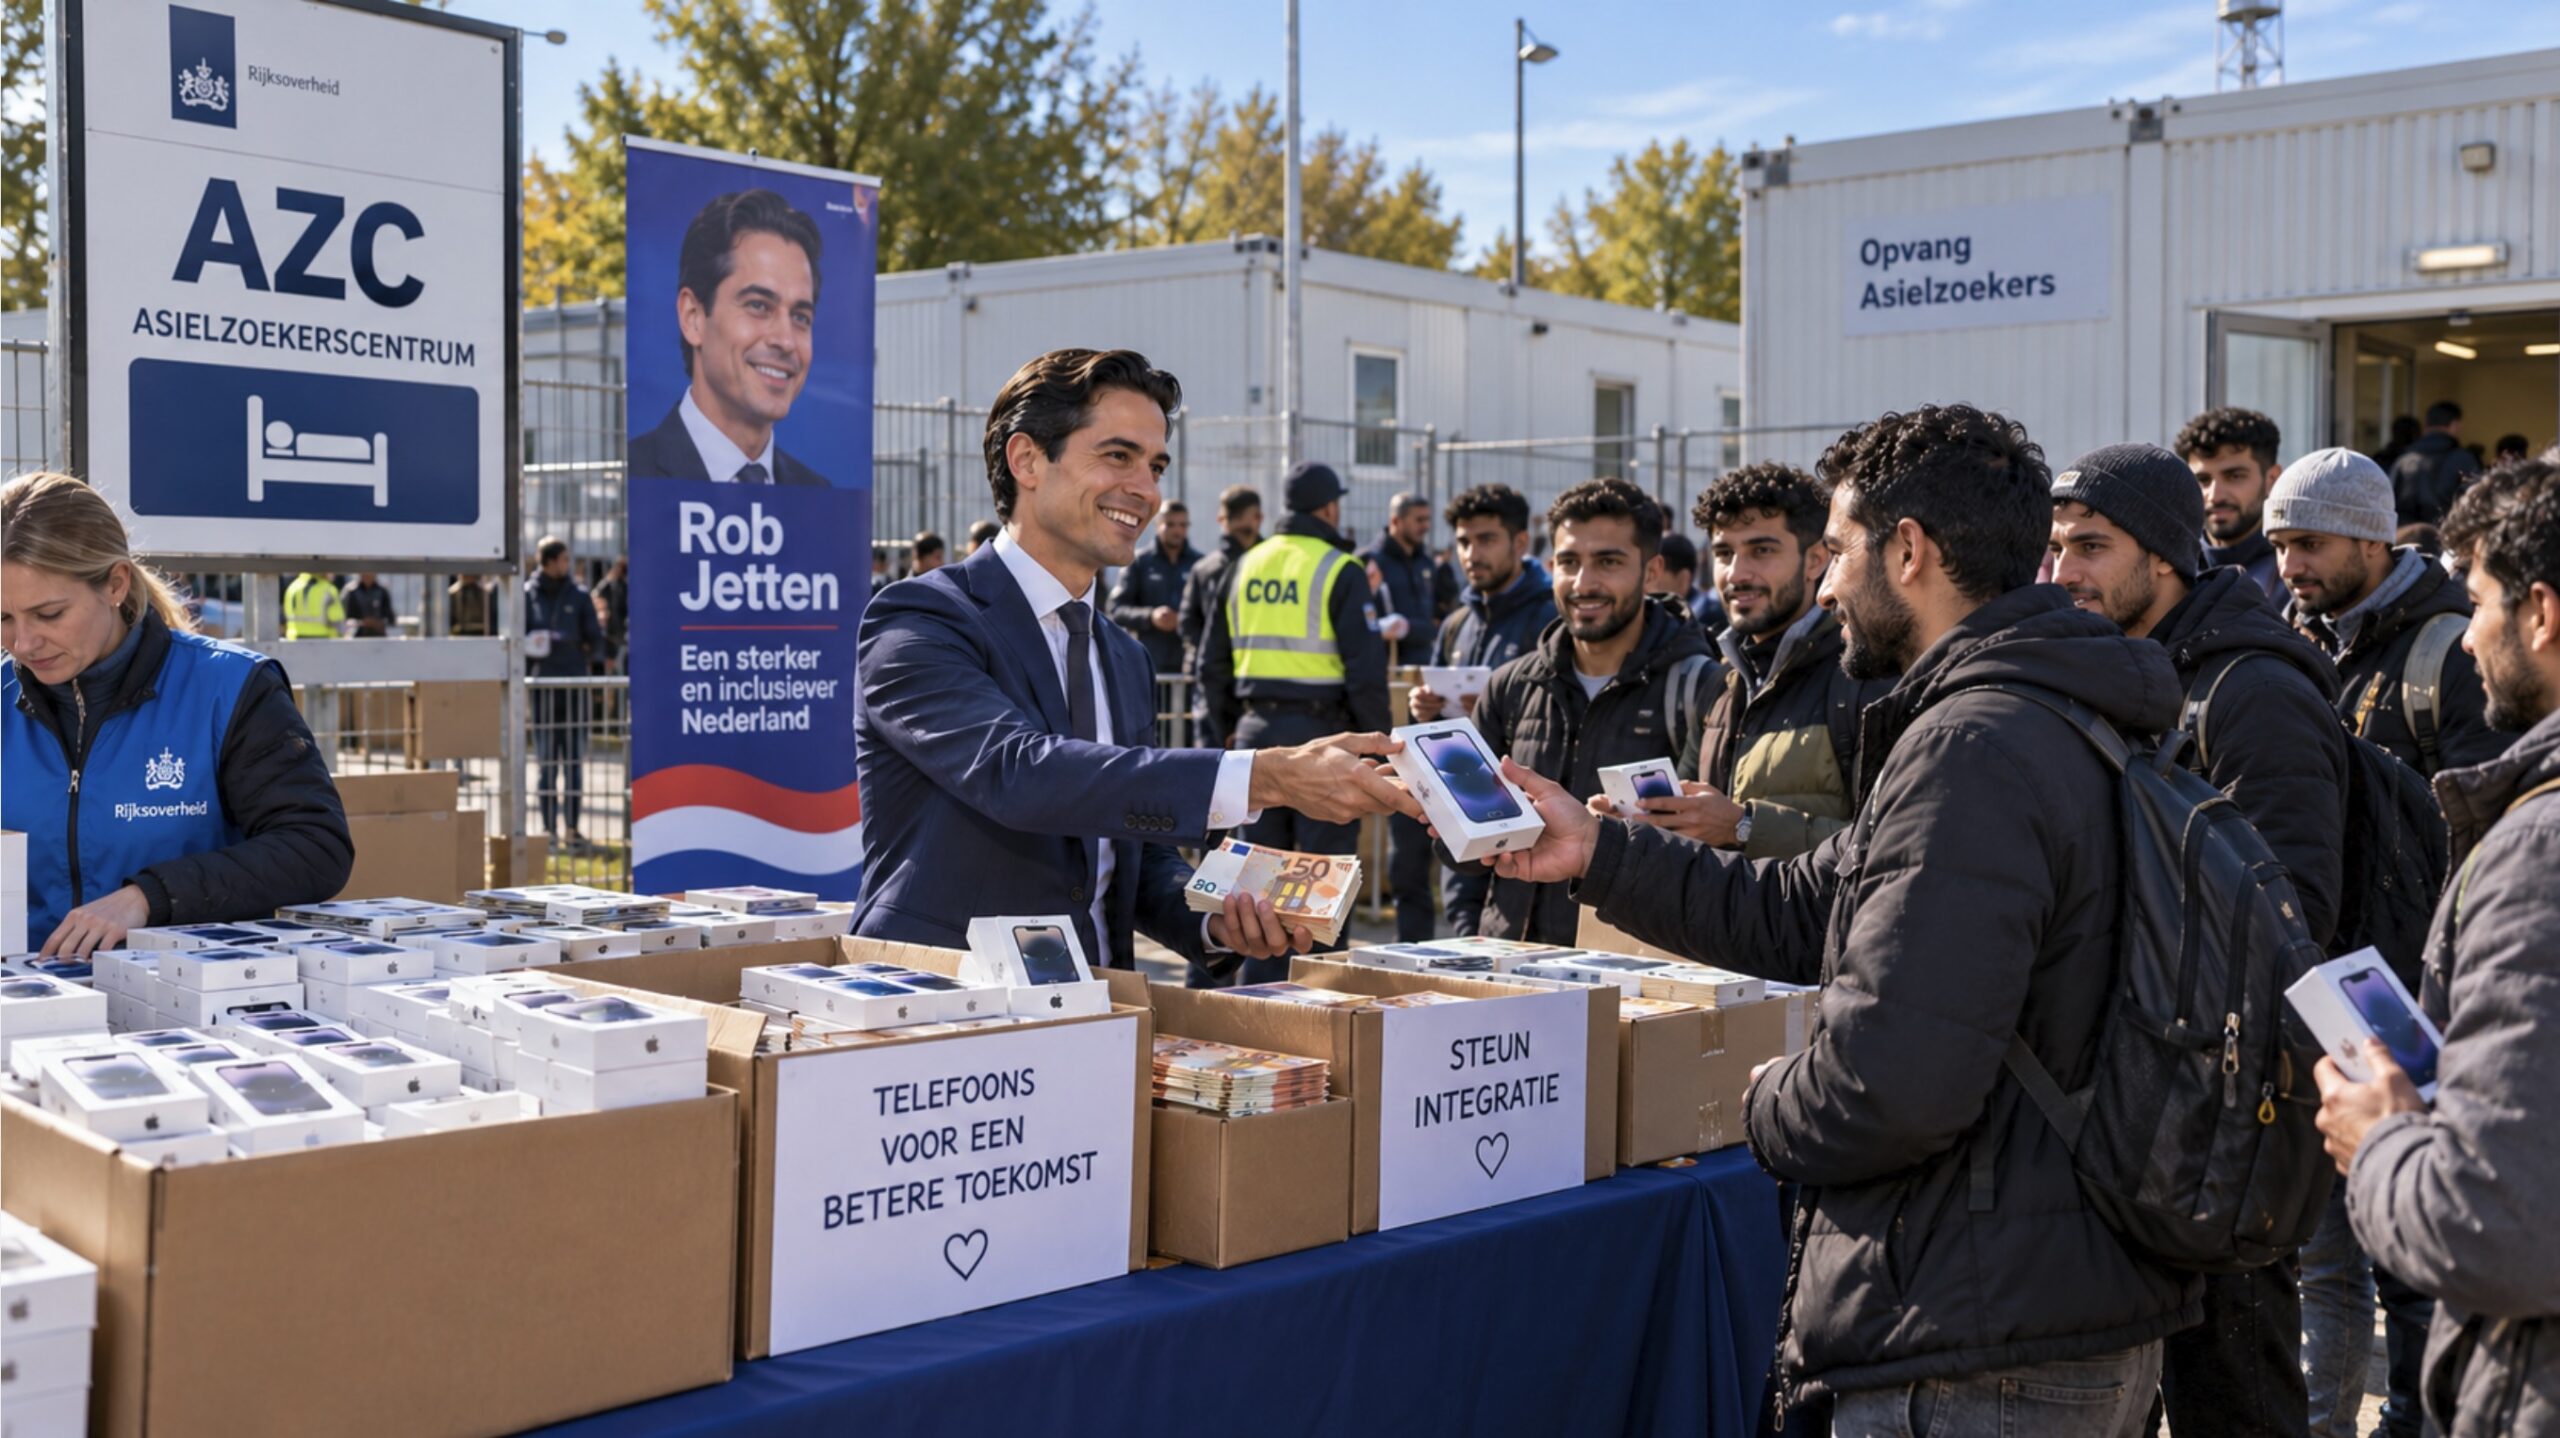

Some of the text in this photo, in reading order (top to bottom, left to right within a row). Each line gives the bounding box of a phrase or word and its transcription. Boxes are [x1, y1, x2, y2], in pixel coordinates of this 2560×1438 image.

[247, 64, 340, 96] Rijksoverheid
[172, 177, 426, 308] AZC
[1860, 236, 1971, 271] Opvang
[1859, 270, 2056, 310] Asielzoekers
[133, 307, 476, 367] ASIELZOEKERSCENTRUM
[679, 501, 785, 556] Rob
[679, 559, 840, 611] Jetten
[1245, 578, 1299, 605] COA
[680, 644, 821, 671] Een sterker
[681, 675, 838, 702] en inclusiever
[682, 705, 810, 735] Nederland
[115, 801, 208, 822] Rijksoverheid
[1292, 858, 1330, 879] 50
[1450, 1031, 1530, 1070] STEUN
[873, 1067, 1035, 1116] TELEFOONS
[1415, 1073, 1560, 1128] INTEGRATIE
[881, 1115, 1024, 1165] VOOR EEN
[824, 1151, 1098, 1230] BETERE TOEKOMST
